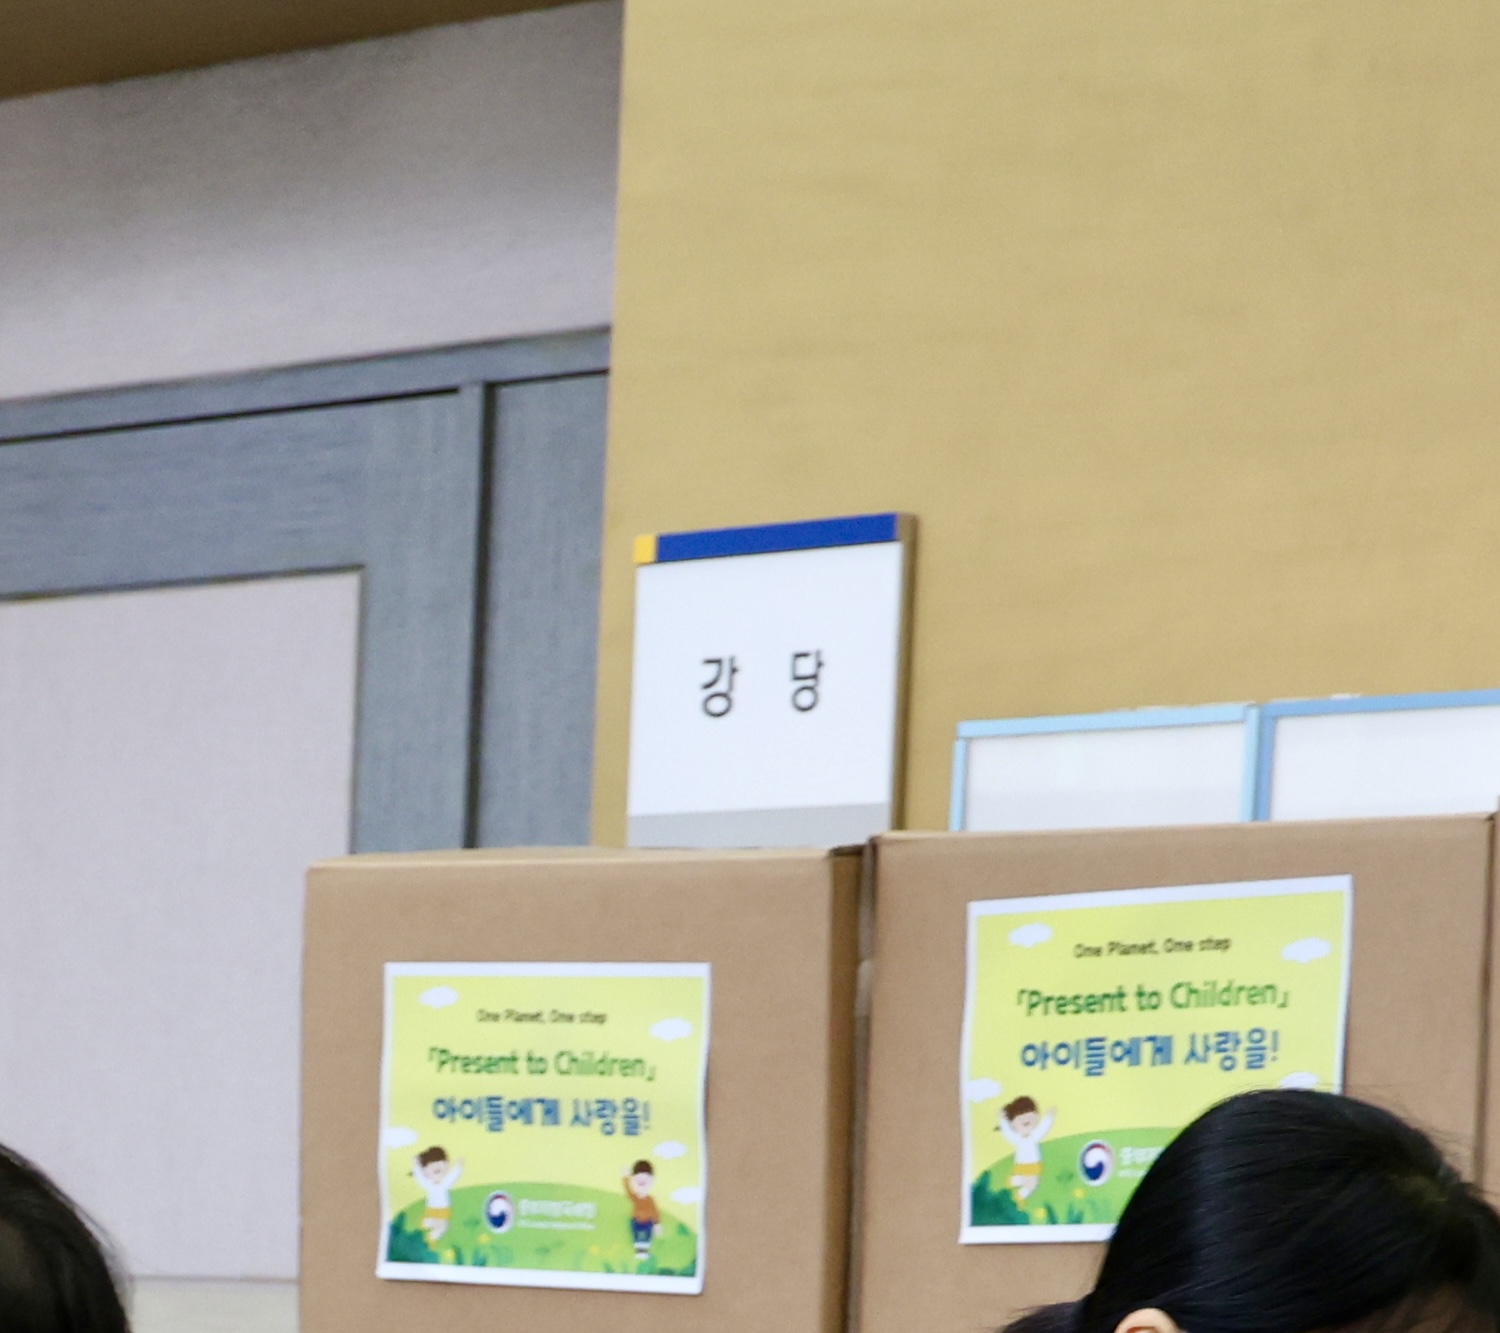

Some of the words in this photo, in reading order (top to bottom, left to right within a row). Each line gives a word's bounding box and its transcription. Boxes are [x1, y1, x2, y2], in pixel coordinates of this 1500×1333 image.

[1074, 942, 1102, 958] One
[1107, 940, 1158, 957] Planet,
[1164, 938, 1192, 954] One
[1198, 935, 1231, 953] step
[1136, 985, 1160, 1011] to
[528, 1052, 548, 1075] to
[1020, 1034, 1173, 1077] 아이들에게
[1184, 1027, 1280, 1072] 사랑을!
[432, 1095, 561, 1133] 아이들에게
[570, 1096, 650, 1136] 사랑을!
